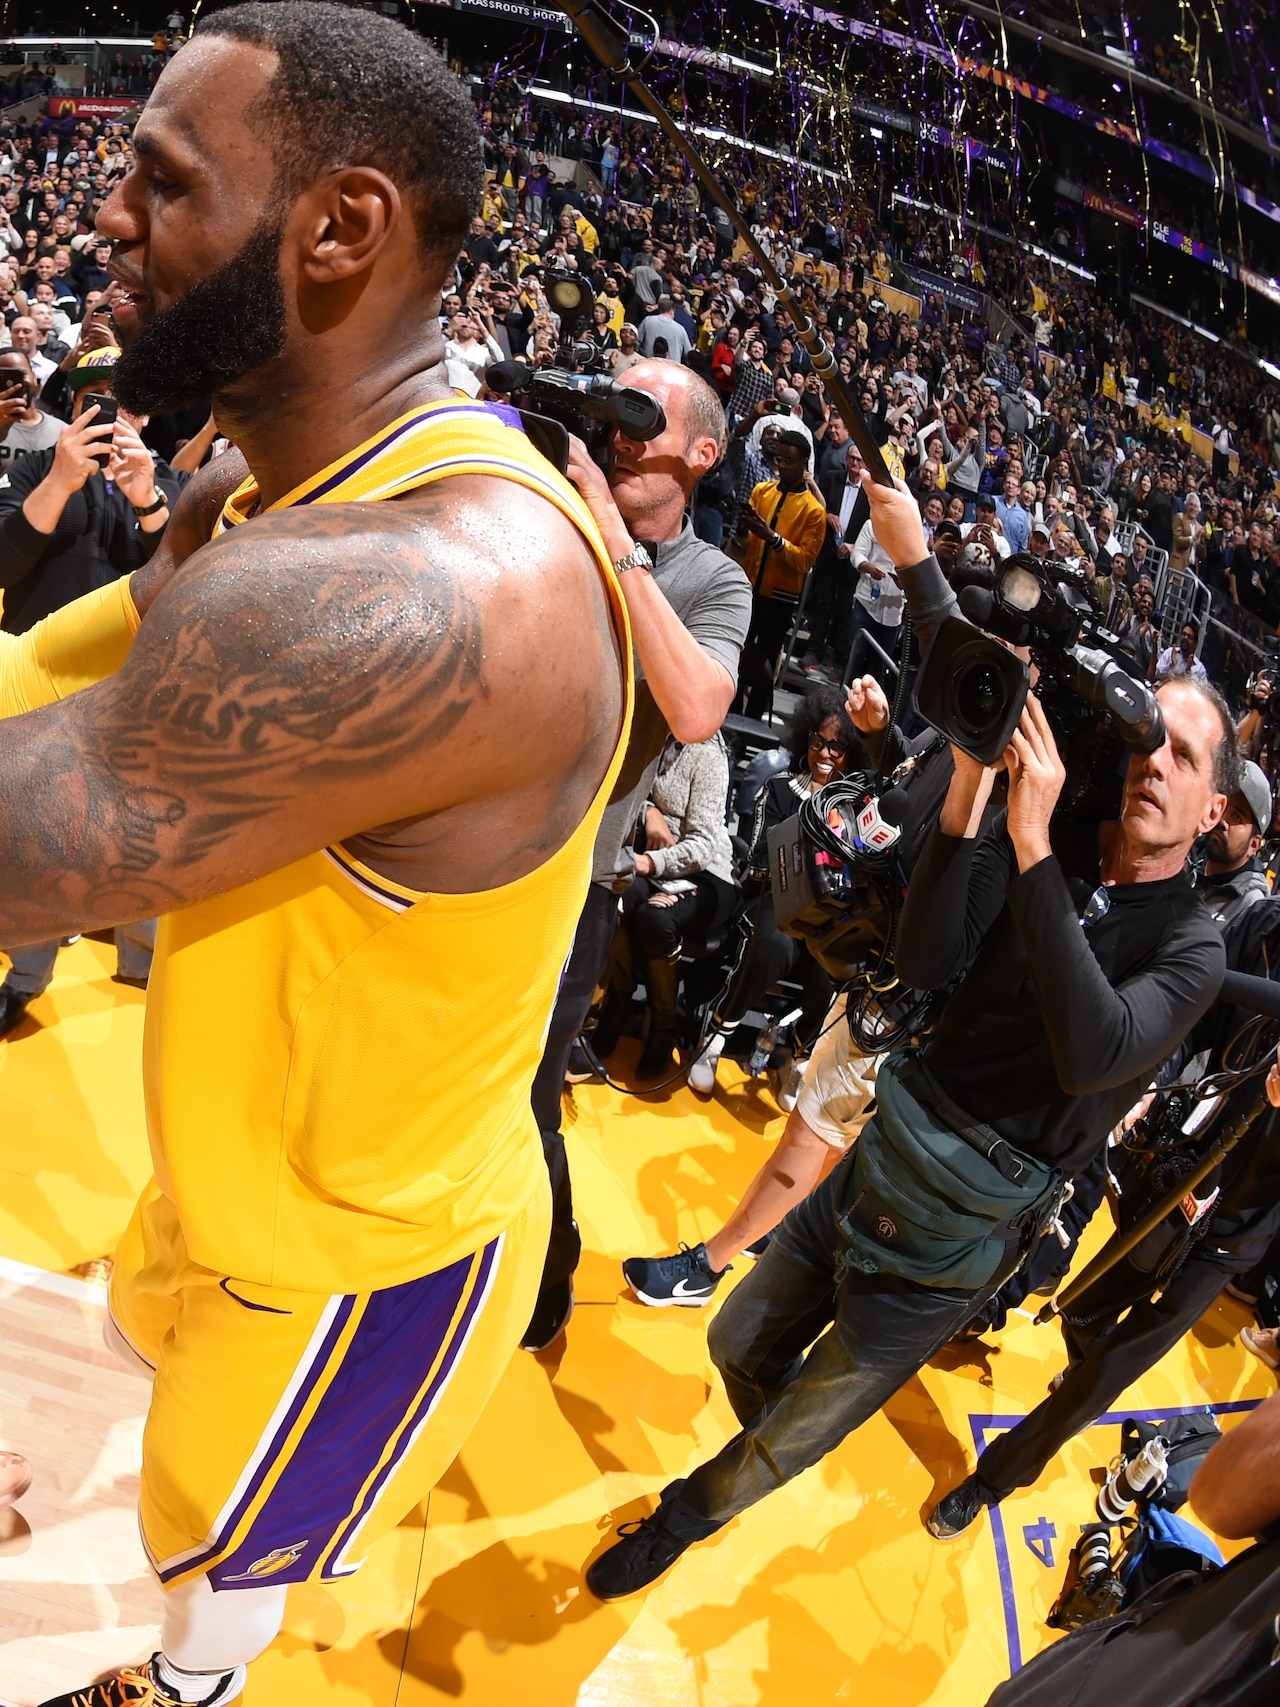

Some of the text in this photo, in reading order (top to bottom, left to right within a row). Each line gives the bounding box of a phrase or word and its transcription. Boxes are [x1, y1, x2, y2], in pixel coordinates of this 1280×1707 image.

[1152, 220, 1170, 236] CLE
[1152, 229, 1168, 244] MIL
[1022, 1516, 1057, 1568] 4
